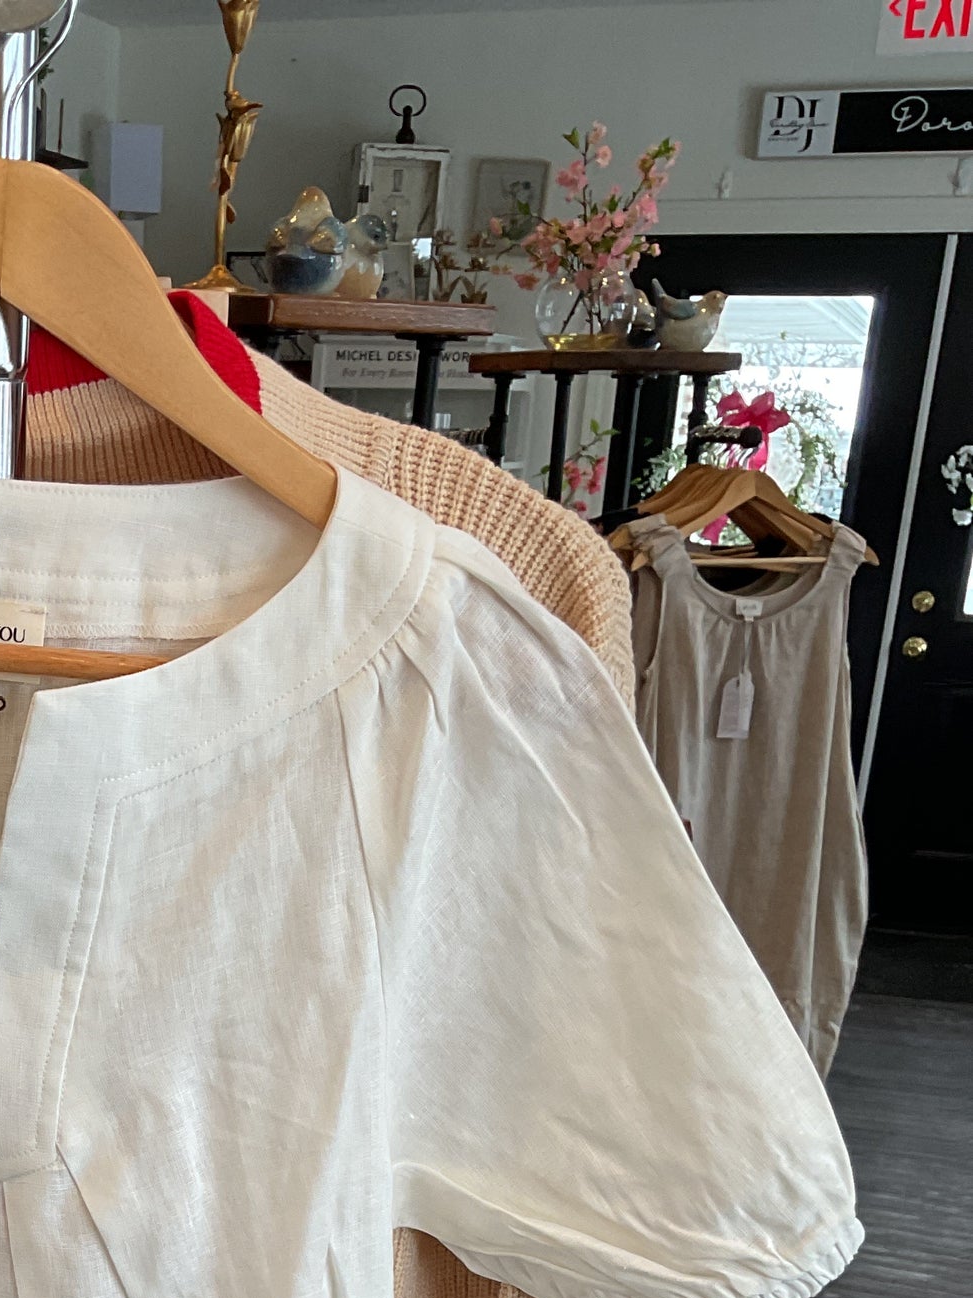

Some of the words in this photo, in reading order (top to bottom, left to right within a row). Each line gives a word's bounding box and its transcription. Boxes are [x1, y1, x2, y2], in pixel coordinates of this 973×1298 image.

[336, 350, 382, 361] MICHEL
[387, 350, 416, 362] DESI
[441, 351, 469, 362] WOR
